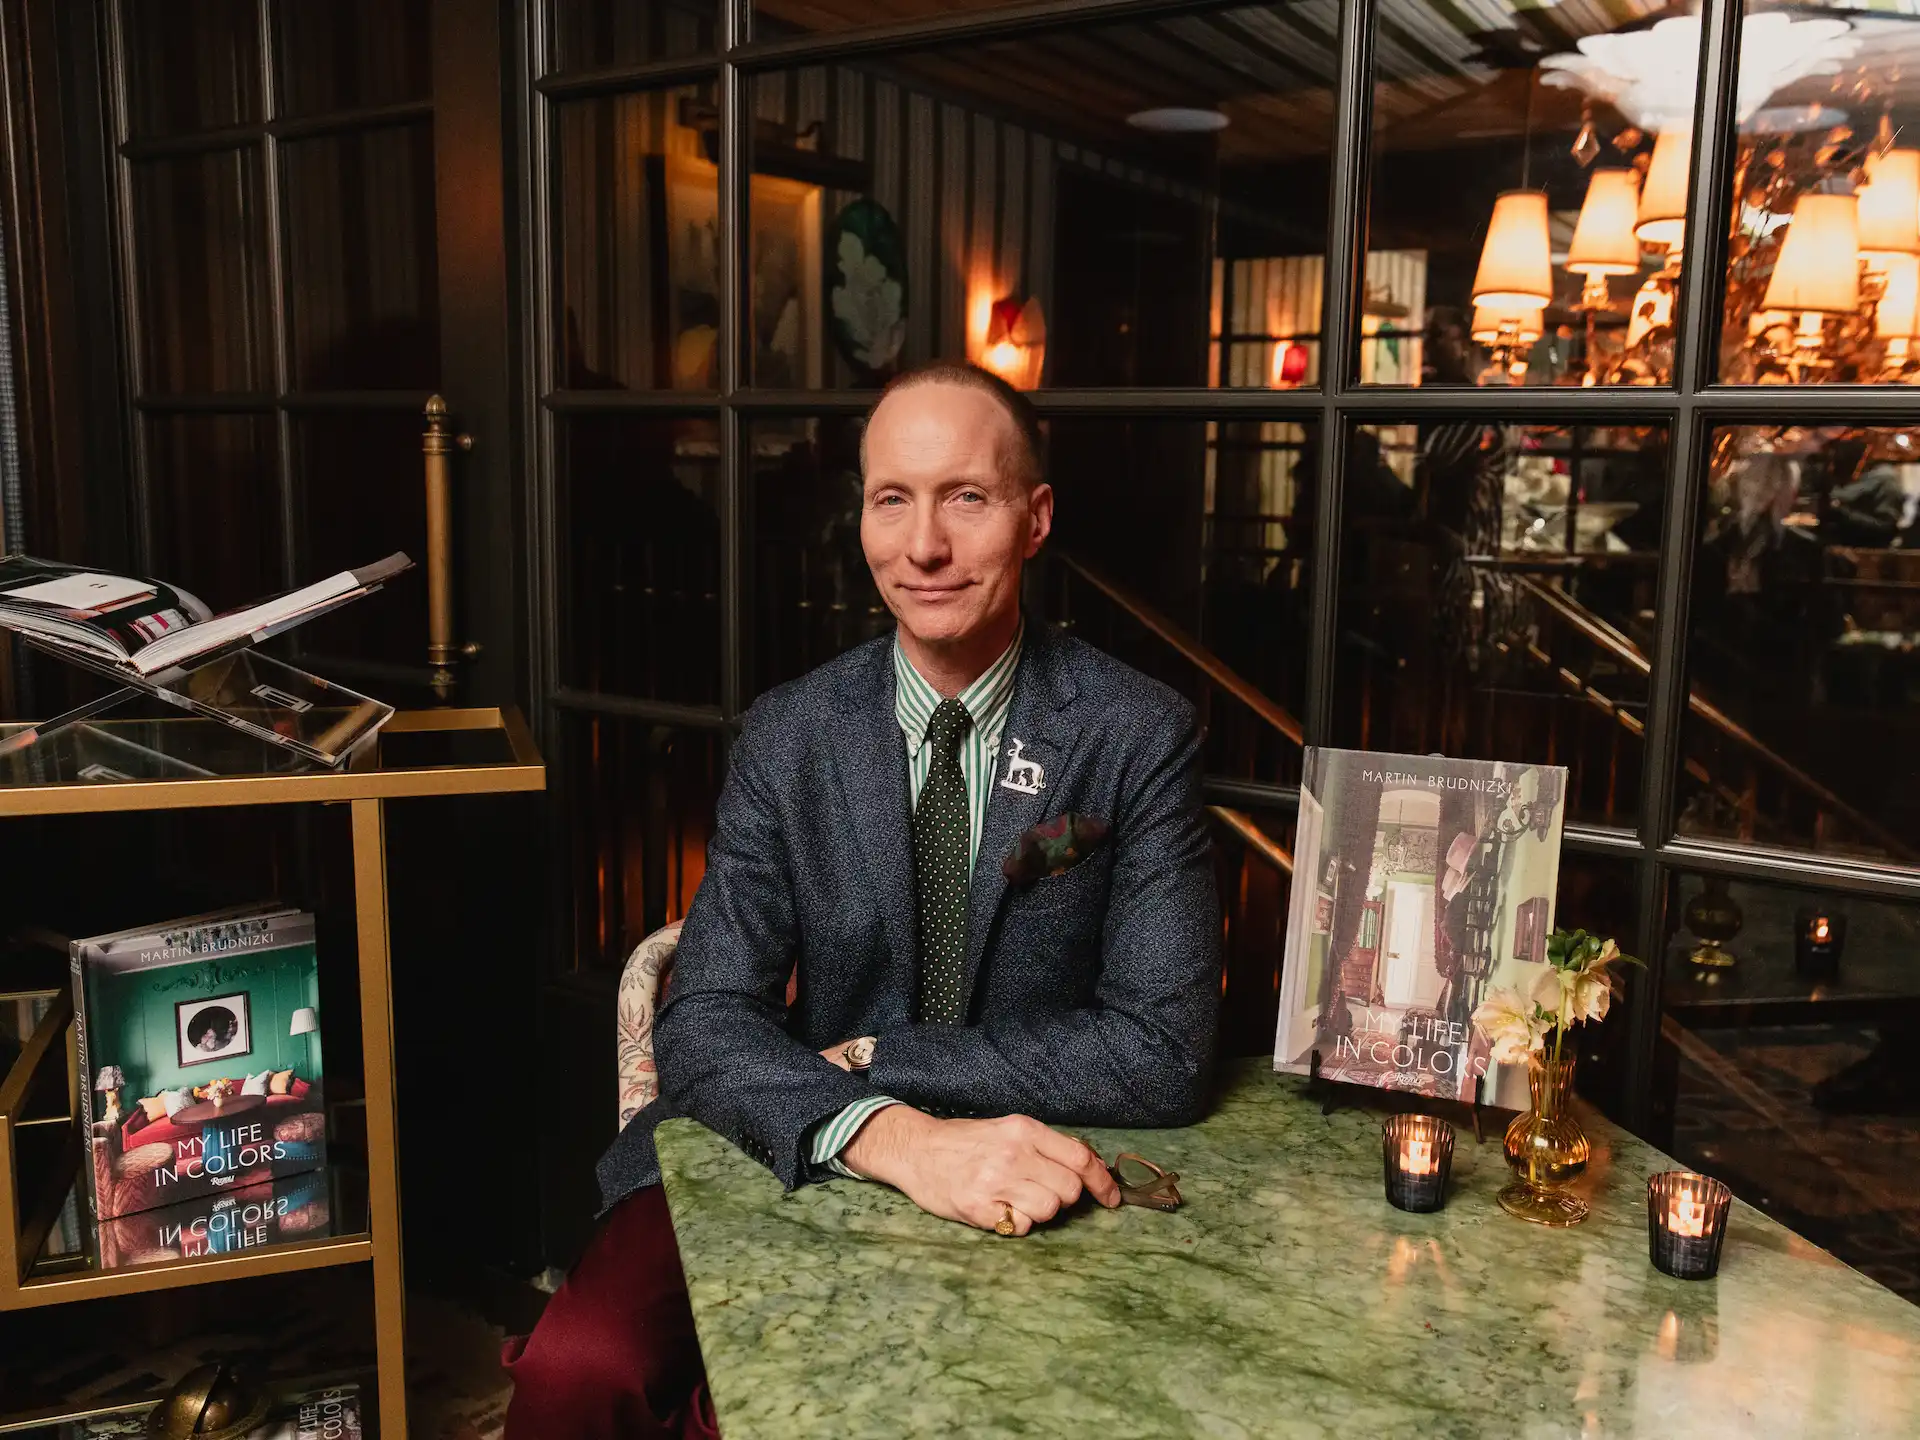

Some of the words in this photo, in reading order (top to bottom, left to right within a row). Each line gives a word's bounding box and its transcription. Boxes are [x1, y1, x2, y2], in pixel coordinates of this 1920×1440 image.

[1362, 769, 1417, 785] MARTIN
[1428, 775, 1512, 794] BRUDNIZKI
[140, 945, 192, 963] MARTIN
[201, 932, 274, 953] BRUDNIZKI
[76, 1010, 86, 1065] MARTIN
[1365, 1008, 1403, 1036] MY
[1412, 1016, 1462, 1045] LIFE
[1335, 1035, 1361, 1060] IN
[1370, 1041, 1487, 1080] COLORS
[80, 1074, 92, 1153] BRUDNIZKI
[177, 1134, 211, 1159] MY
[219, 1123, 263, 1149] LIFE
[154, 1165, 179, 1188] IN
[186, 1140, 287, 1179] COLORS
[299, 1404, 319, 1429] LIFE
